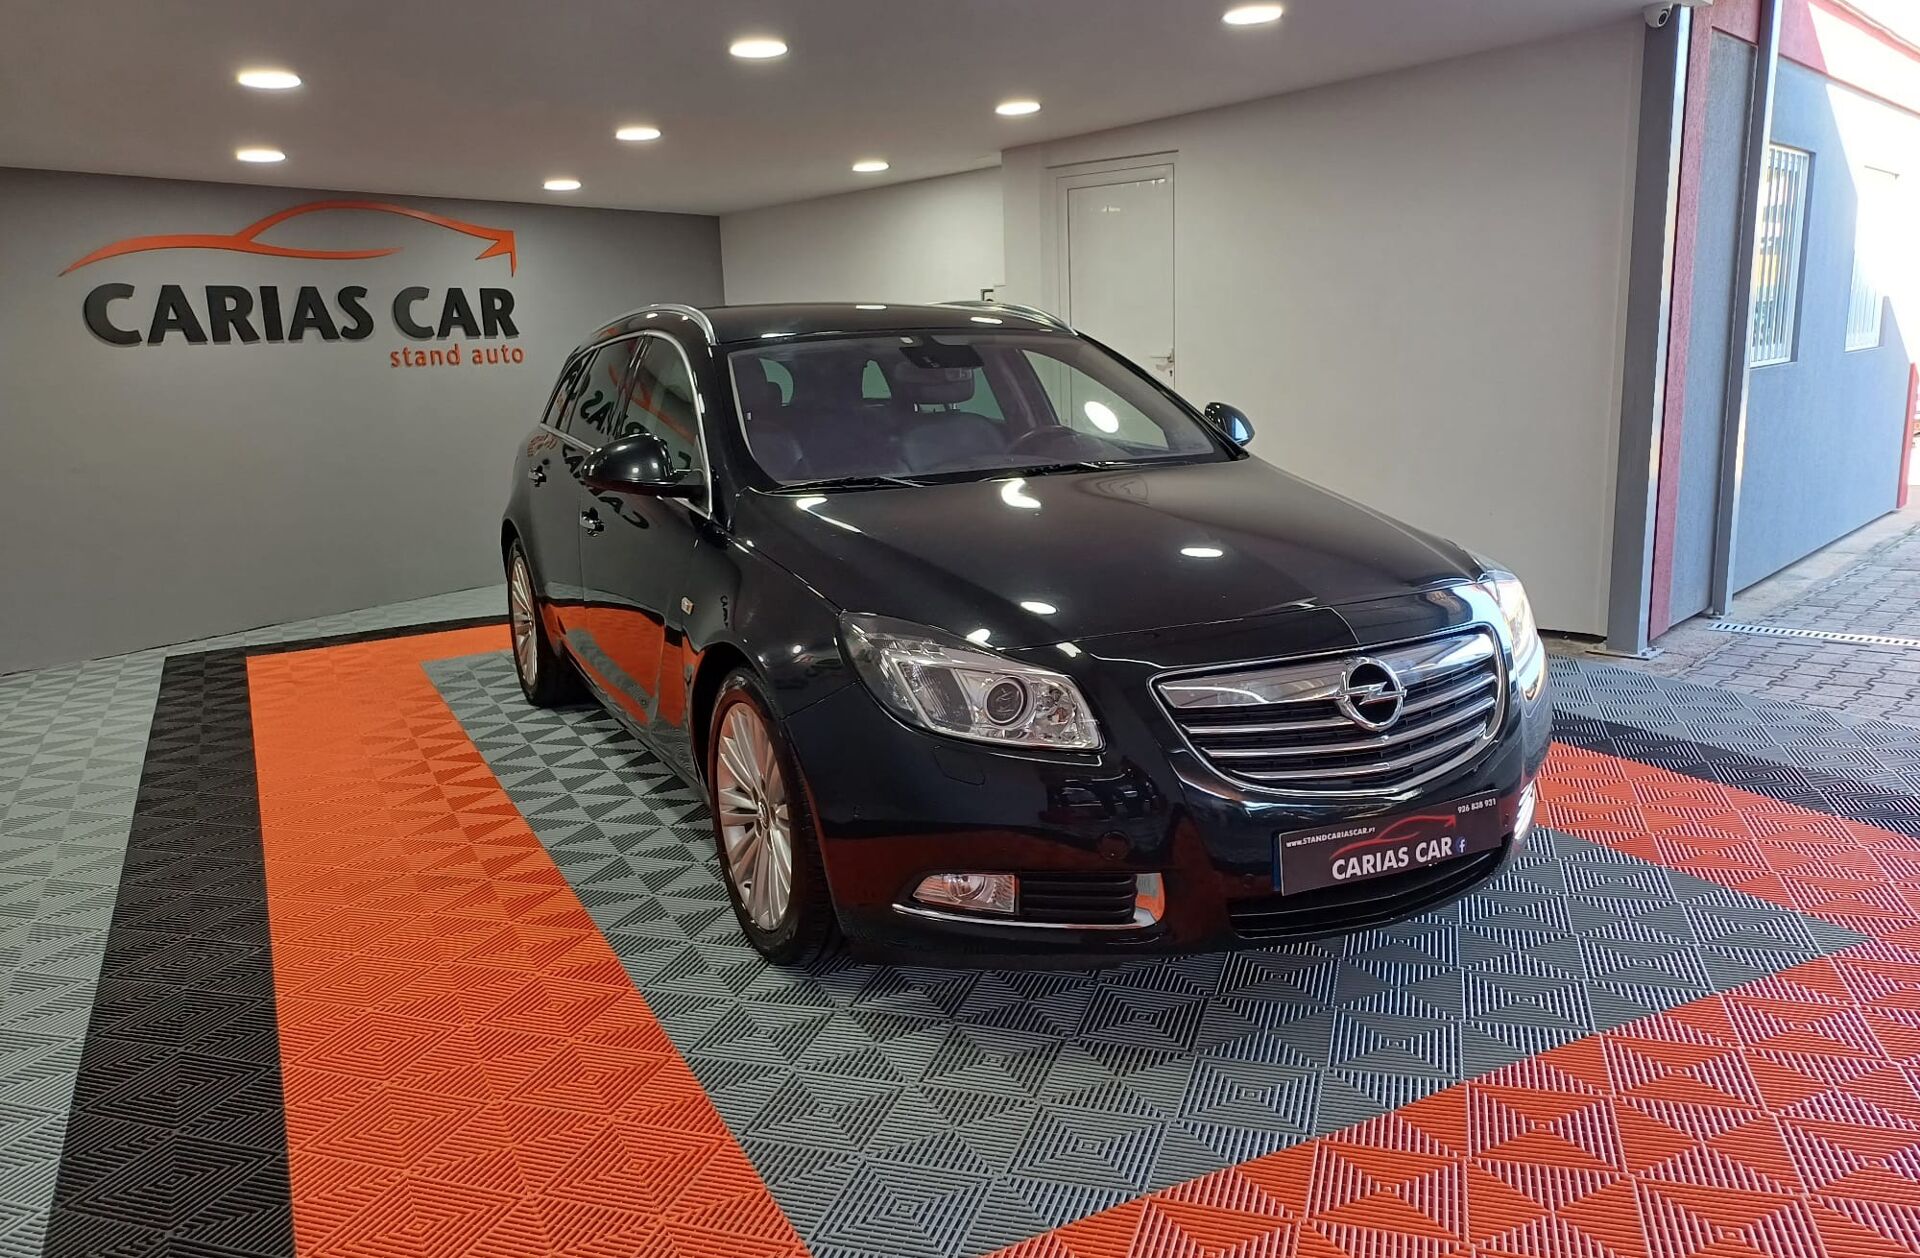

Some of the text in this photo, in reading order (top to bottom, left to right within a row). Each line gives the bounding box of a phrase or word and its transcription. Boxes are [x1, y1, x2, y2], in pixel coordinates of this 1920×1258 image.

[83, 283, 520, 345] CARIAS CAR
[390, 344, 525, 368] stand auto
[1331, 836, 1453, 880] CARIAS CAR
